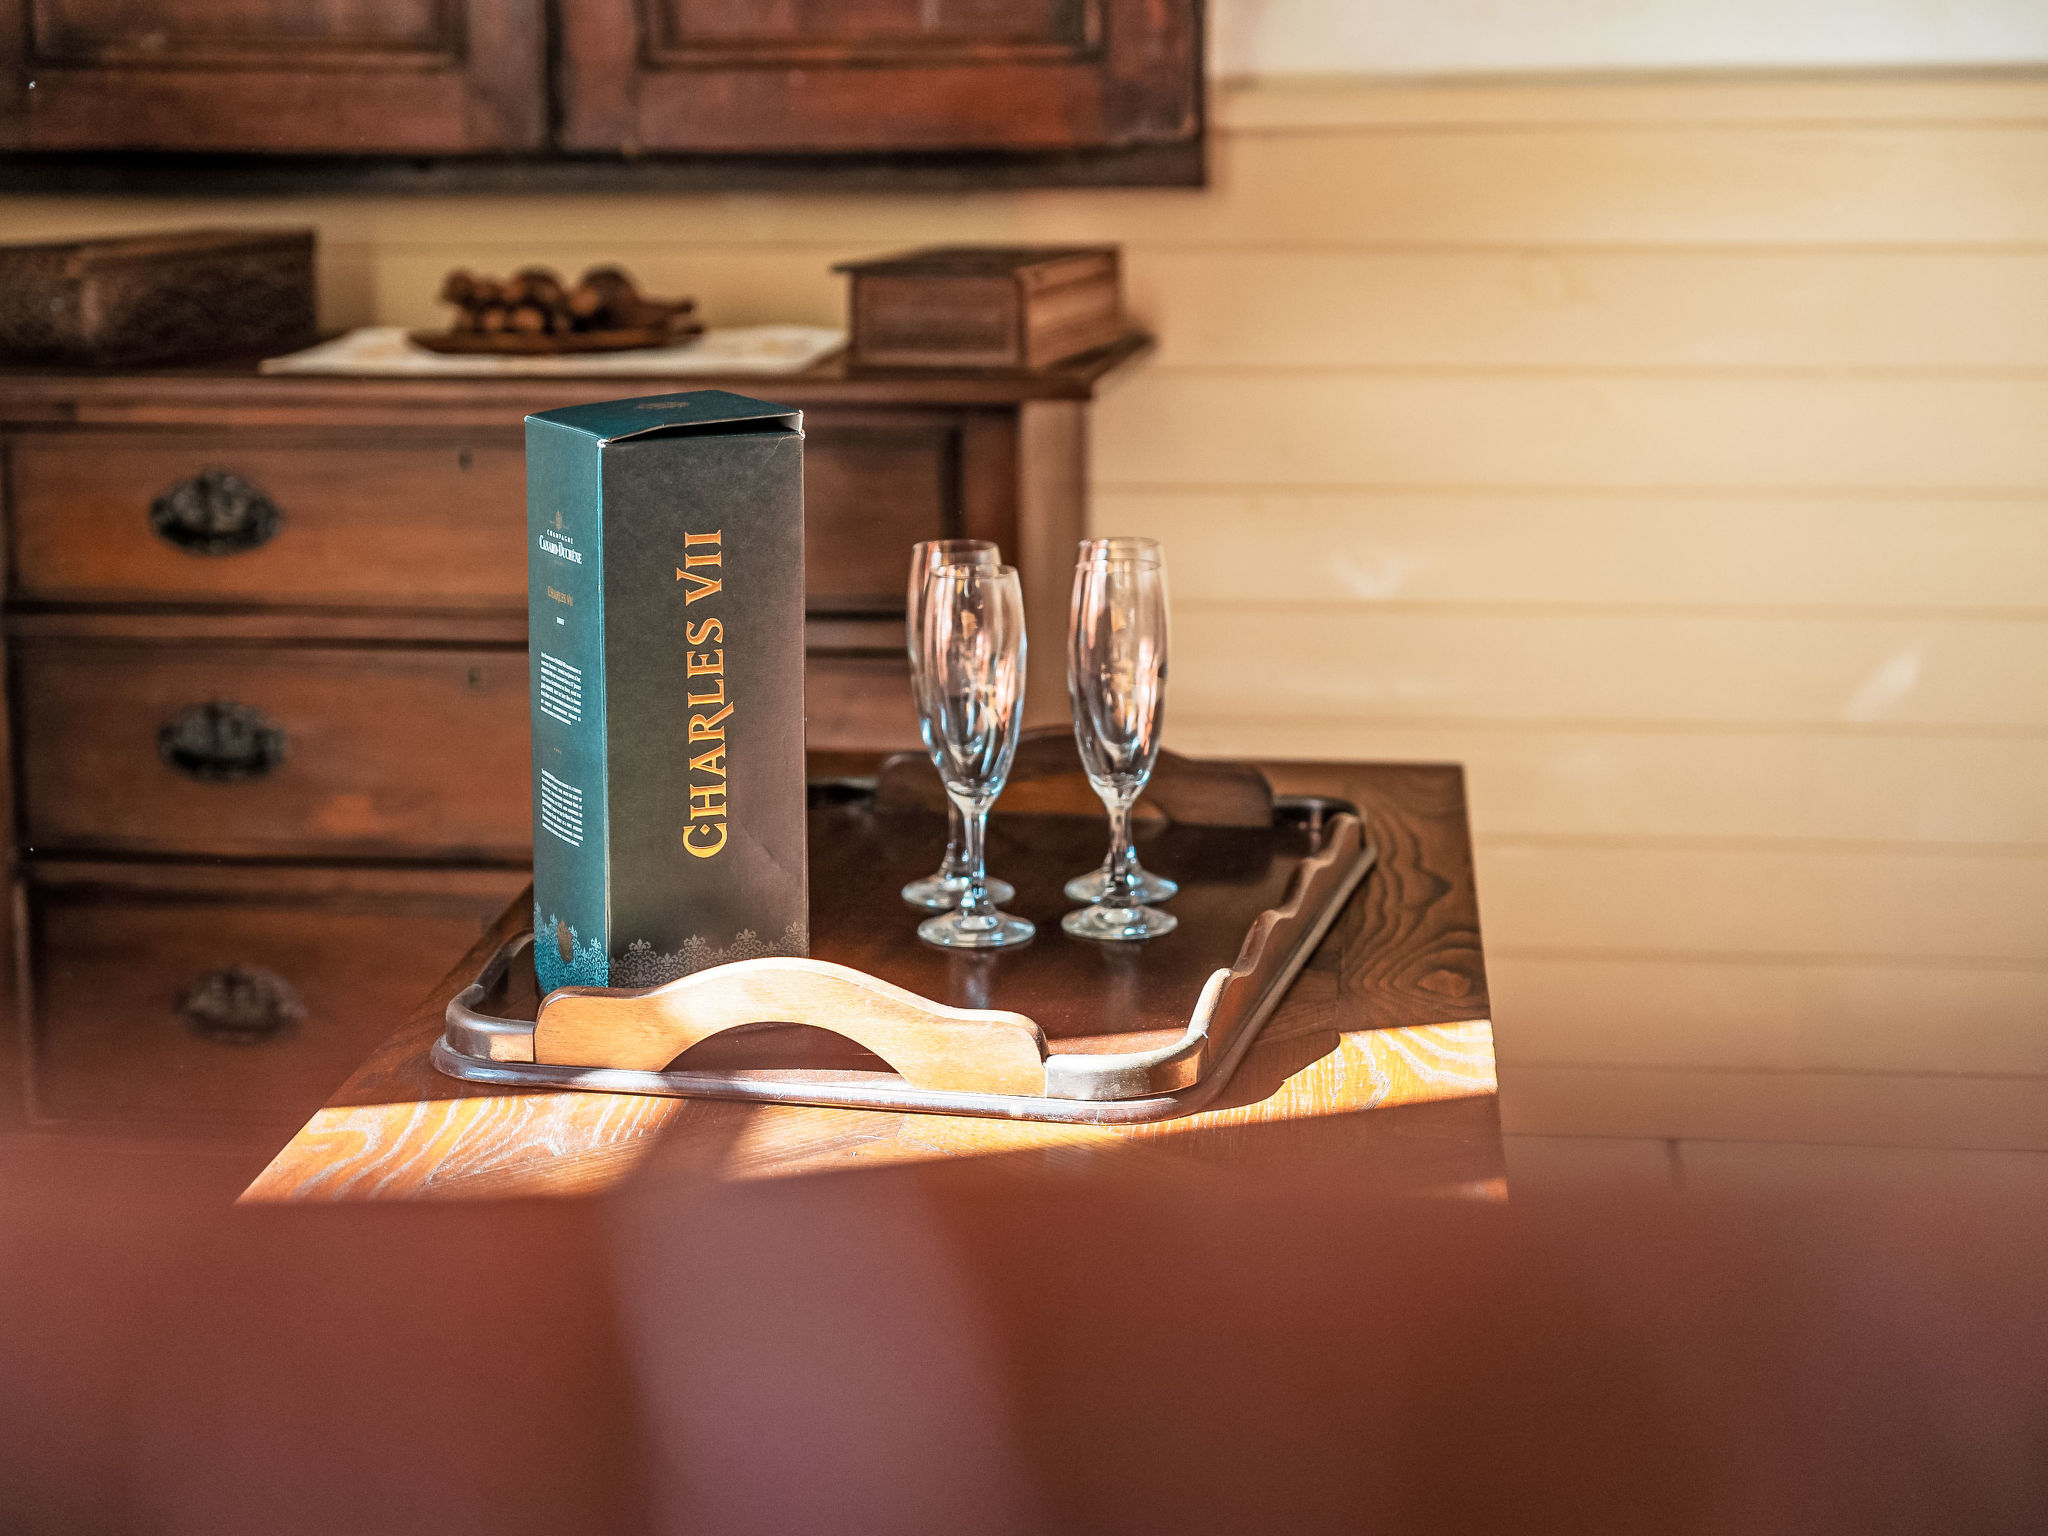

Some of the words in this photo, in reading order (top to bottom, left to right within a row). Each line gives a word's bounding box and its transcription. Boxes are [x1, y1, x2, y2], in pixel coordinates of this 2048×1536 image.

[547, 529, 574, 544] CHAMPAGNE
[676, 529, 722, 607] VII
[682, 617, 734, 859] CHARLES
